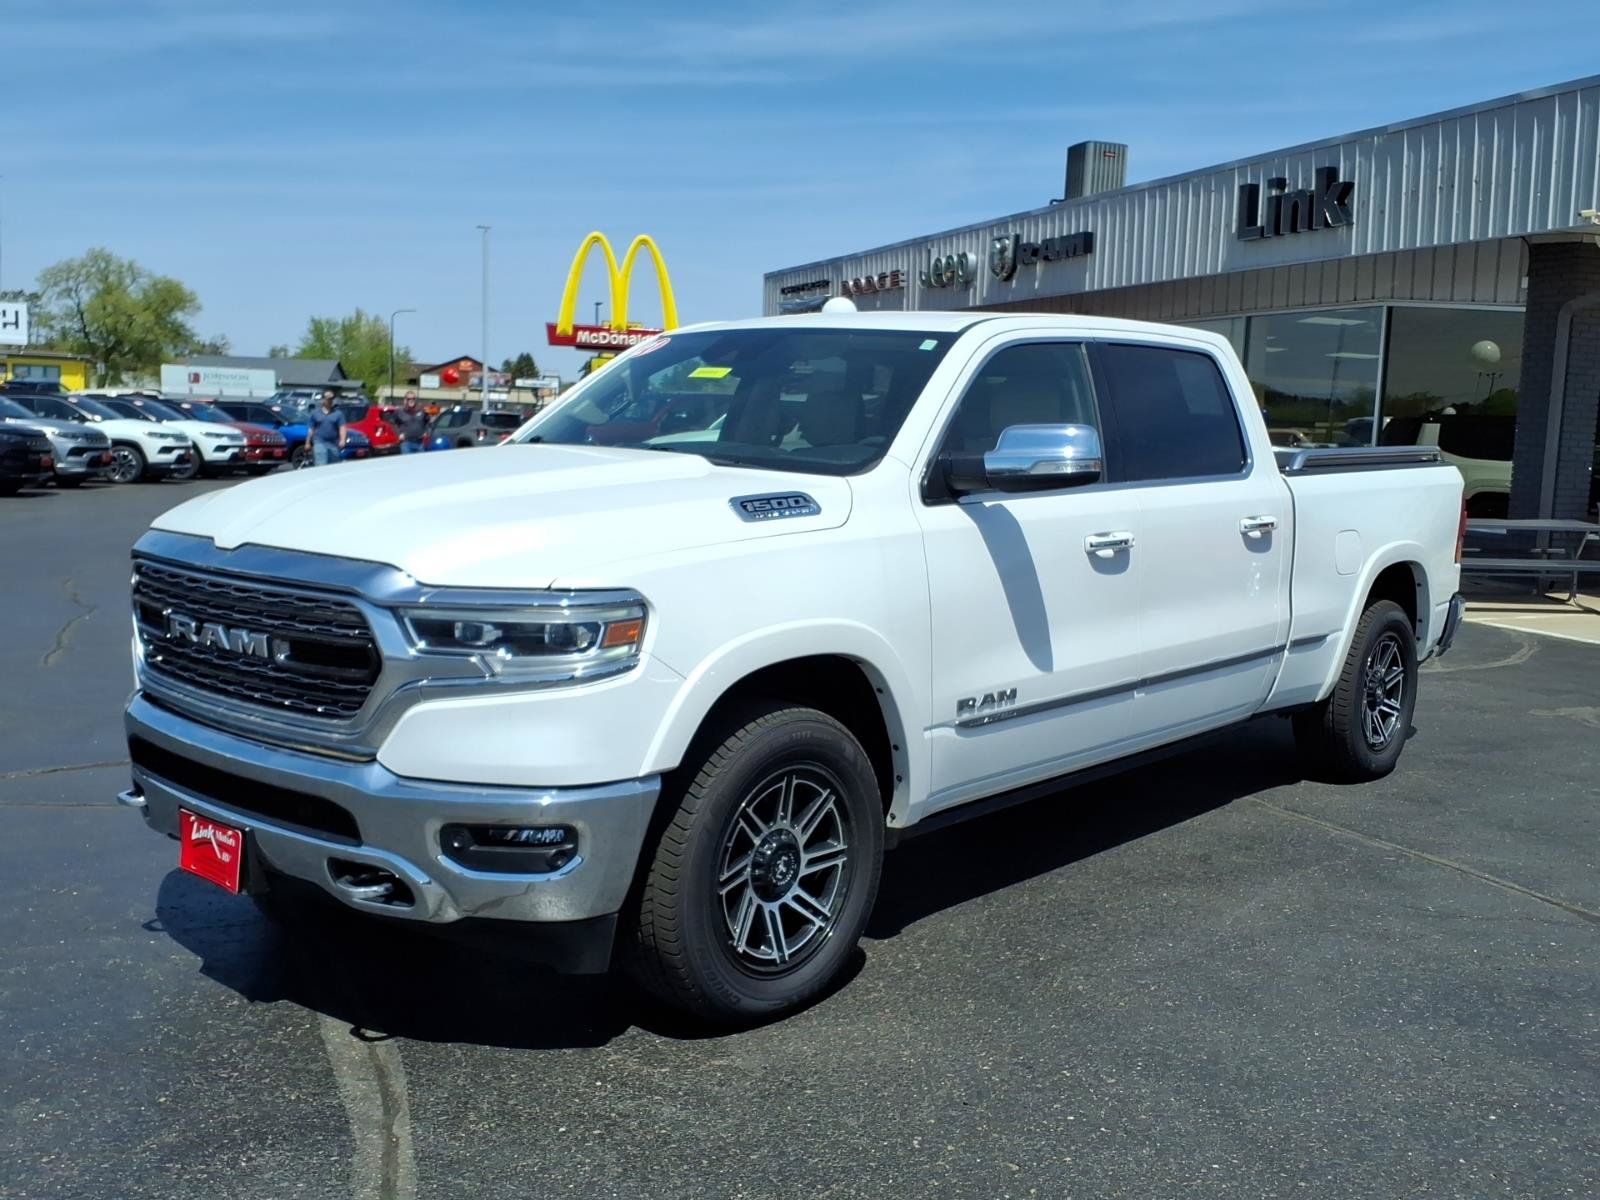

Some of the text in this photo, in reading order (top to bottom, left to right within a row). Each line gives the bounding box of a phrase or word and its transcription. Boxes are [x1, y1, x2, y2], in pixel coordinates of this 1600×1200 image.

[1237, 166, 1355, 241] Link
[841, 270, 903, 297] DODGE
[575, 331, 655, 346] McDonal
[741, 496, 807, 513] 1500
[169, 614, 269, 658] RAM
[957, 688, 1017, 717] RAM
